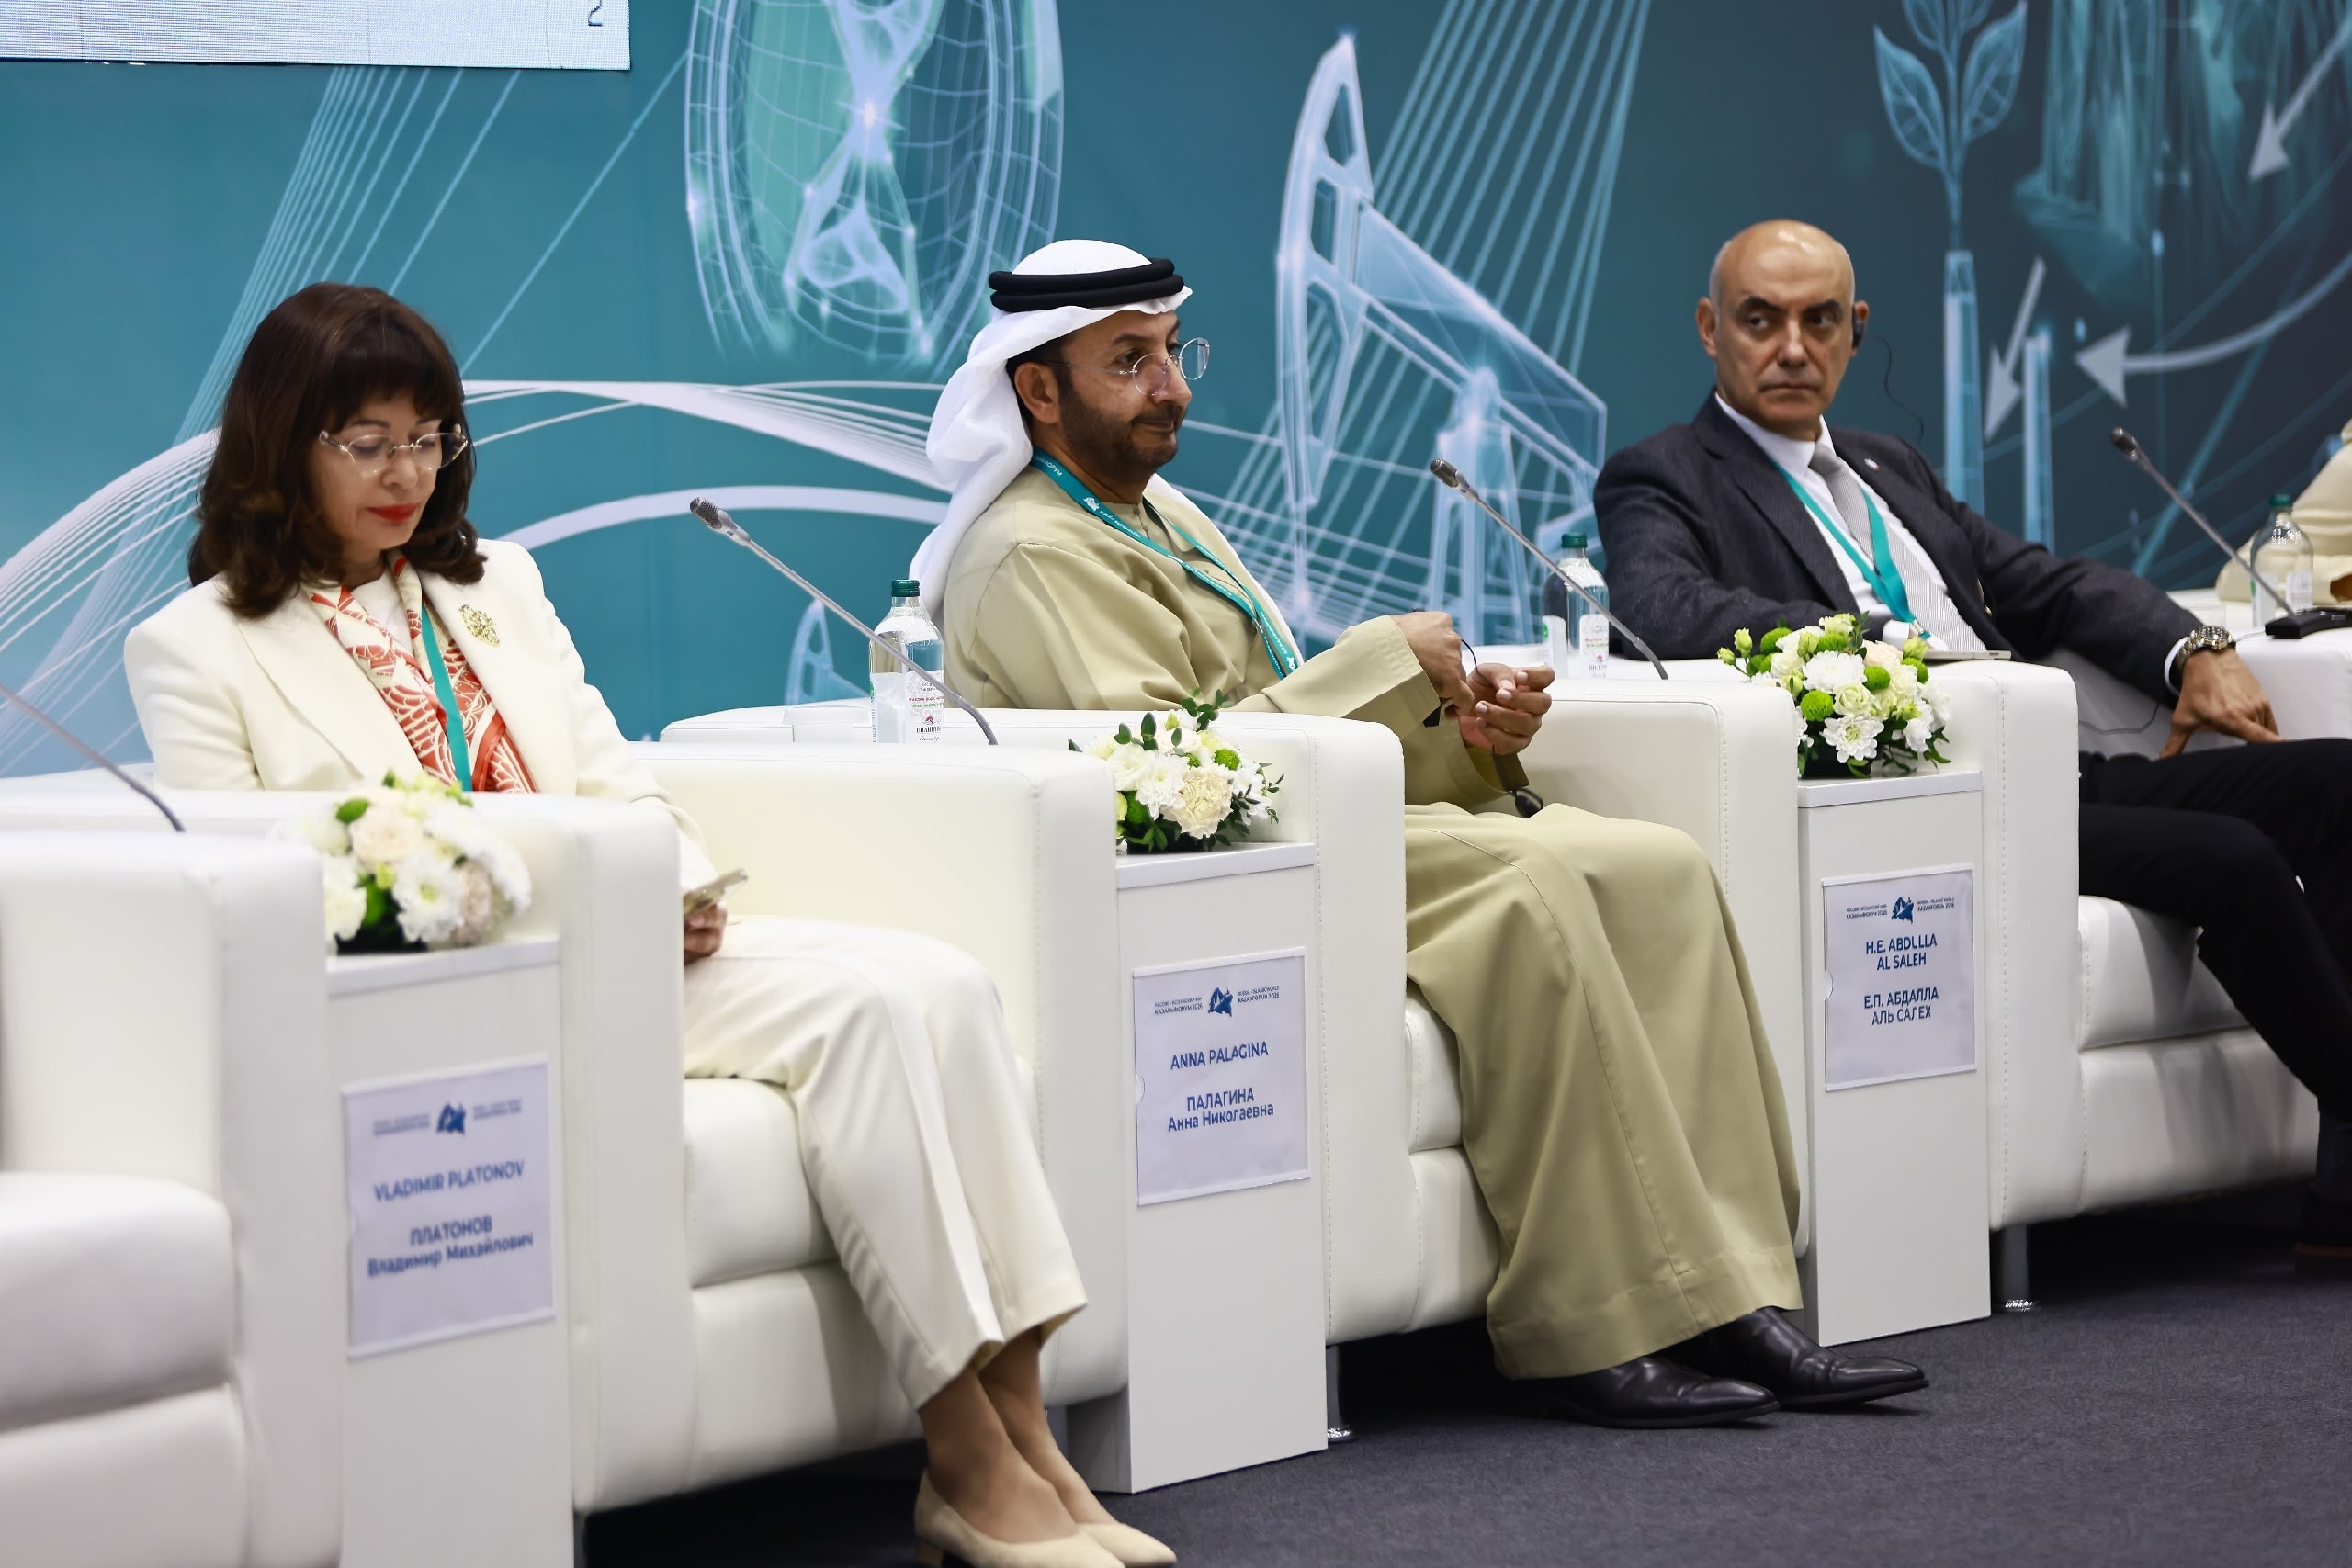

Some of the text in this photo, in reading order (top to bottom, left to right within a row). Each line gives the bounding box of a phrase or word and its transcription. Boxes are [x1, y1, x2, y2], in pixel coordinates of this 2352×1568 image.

[1866, 933, 1938, 954] H.E. ABDULLA
[1876, 952, 1927, 971] AL SALEH
[1864, 987, 1939, 1010] Е.П. АБДАЛЛА
[1896, 1006, 1932, 1021] САЛЕХ
[1170, 1041, 1270, 1070] ANNA PALAGINA
[1187, 1087, 1255, 1111] ПАЛАГИНА
[1168, 1103, 1274, 1133] Анна Николаевна
[373, 1158, 526, 1202] VLADIMIR PLATONOV
[410, 1215, 492, 1247] ПЛАТОНОВ
[368, 1233, 534, 1278] Владимир Михайлович
